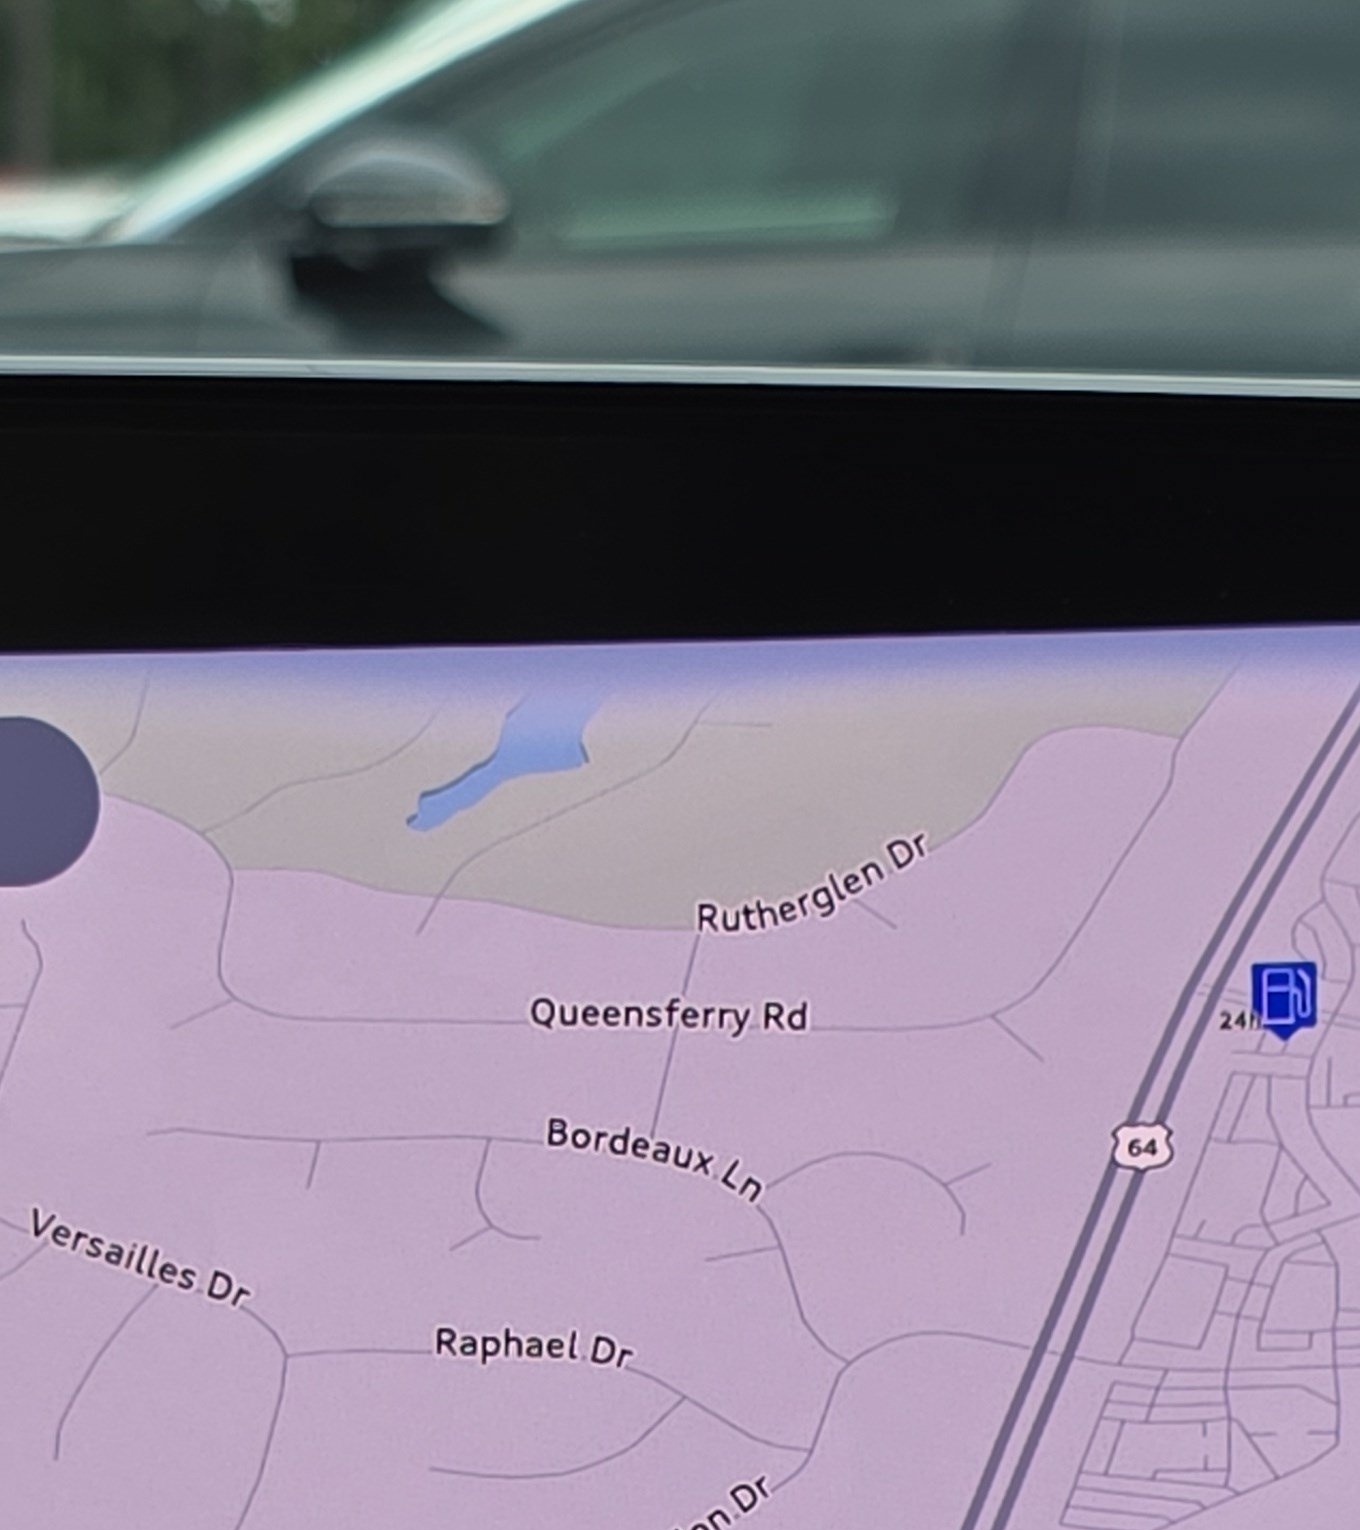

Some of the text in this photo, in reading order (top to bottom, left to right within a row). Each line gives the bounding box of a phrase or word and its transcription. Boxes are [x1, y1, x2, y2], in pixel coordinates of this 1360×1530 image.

[697, 833, 926, 933] Rutherglen Dr
[529, 996, 809, 1039] Queensferry Rd
[546, 1116, 764, 1204] Bordeaux Ln
[1126, 1137, 1159, 1158] 64
[31, 1206, 252, 1307] Versailles Dr
[435, 1326, 634, 1369] Raphael Dr
[728, 1475, 771, 1515] Dr
